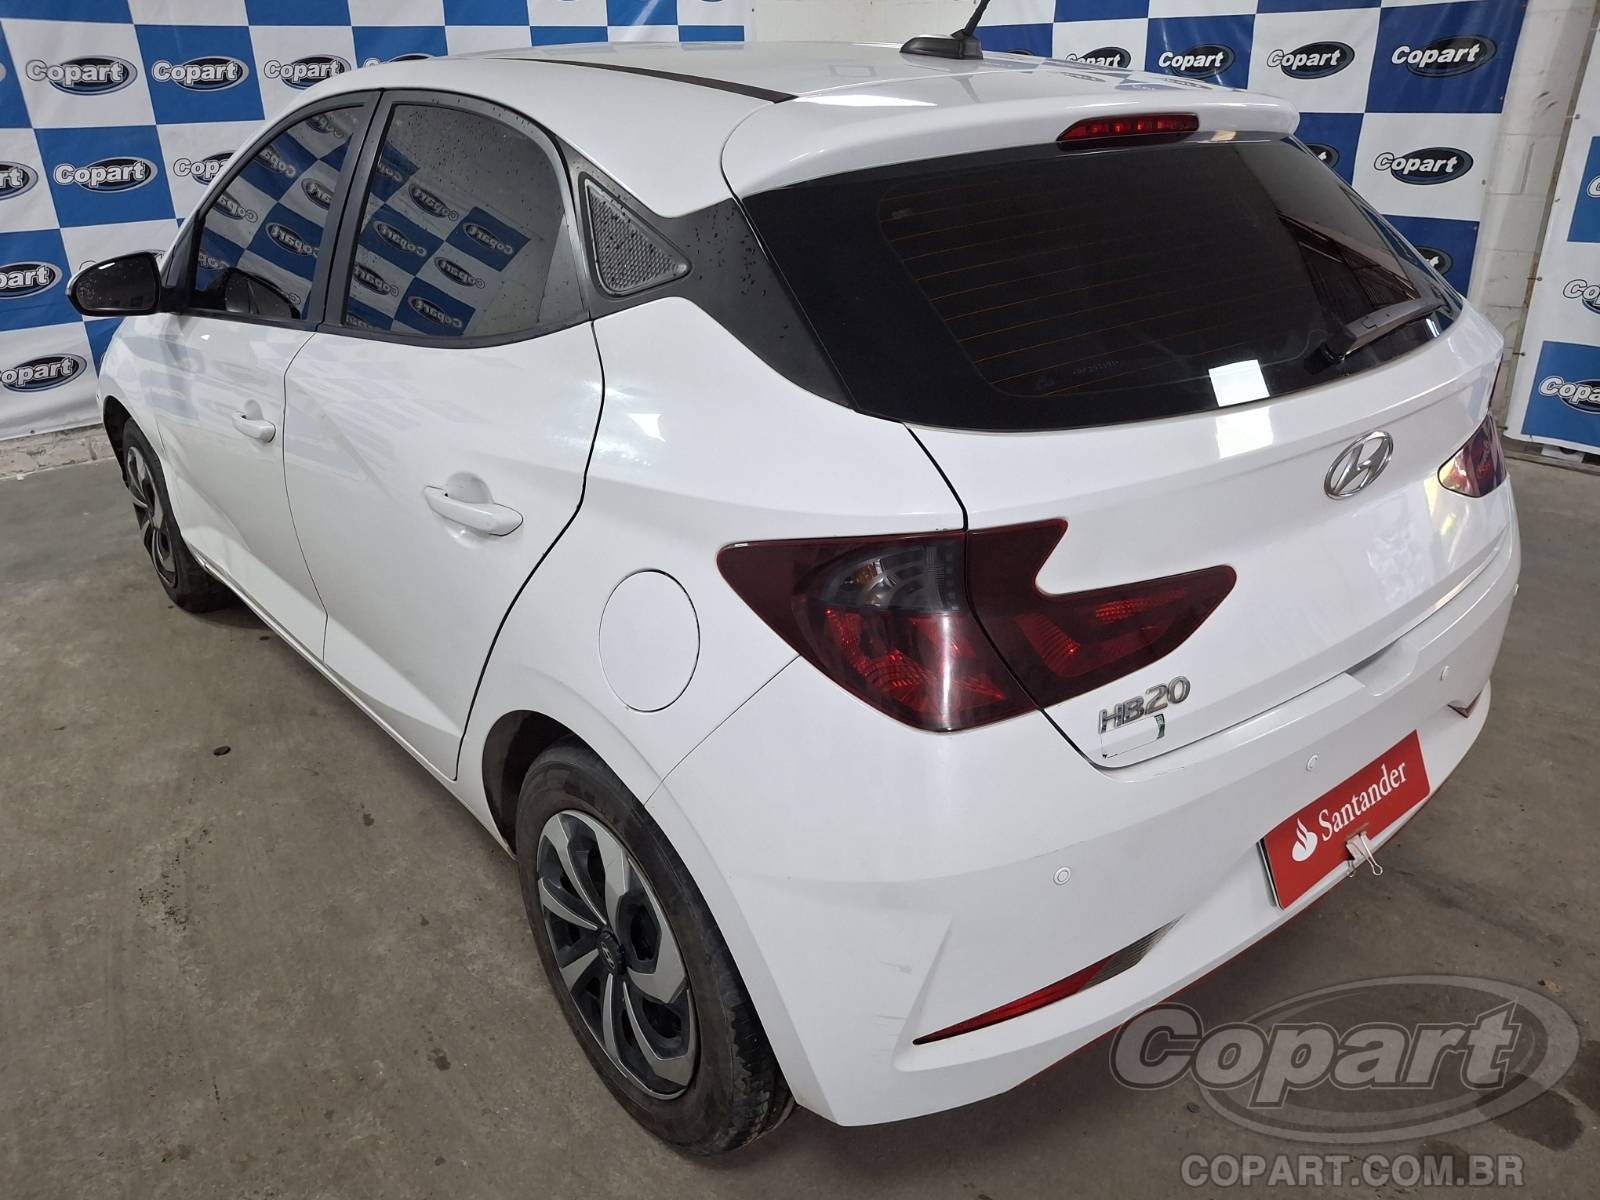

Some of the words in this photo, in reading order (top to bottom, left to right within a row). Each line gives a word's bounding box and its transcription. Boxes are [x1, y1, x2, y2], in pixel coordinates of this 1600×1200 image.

[1158, 50, 1224, 73] Copart
[1266, 48, 1342, 70] Copart
[1391, 43, 1481, 68] Copart
[26, 59, 124, 87] Copart
[152, 60, 238, 86] Copart
[264, 59, 342, 80] Copart
[53, 160, 146, 188] Copart
[173, 157, 226, 178] Cop
[1374, 152, 1458, 175] Copart
[0, 356, 74, 388] opart
[1539, 376, 1600, 405] Copa
[1098, 676, 1191, 735] HB20
[1317, 761, 1407, 841] Santander
